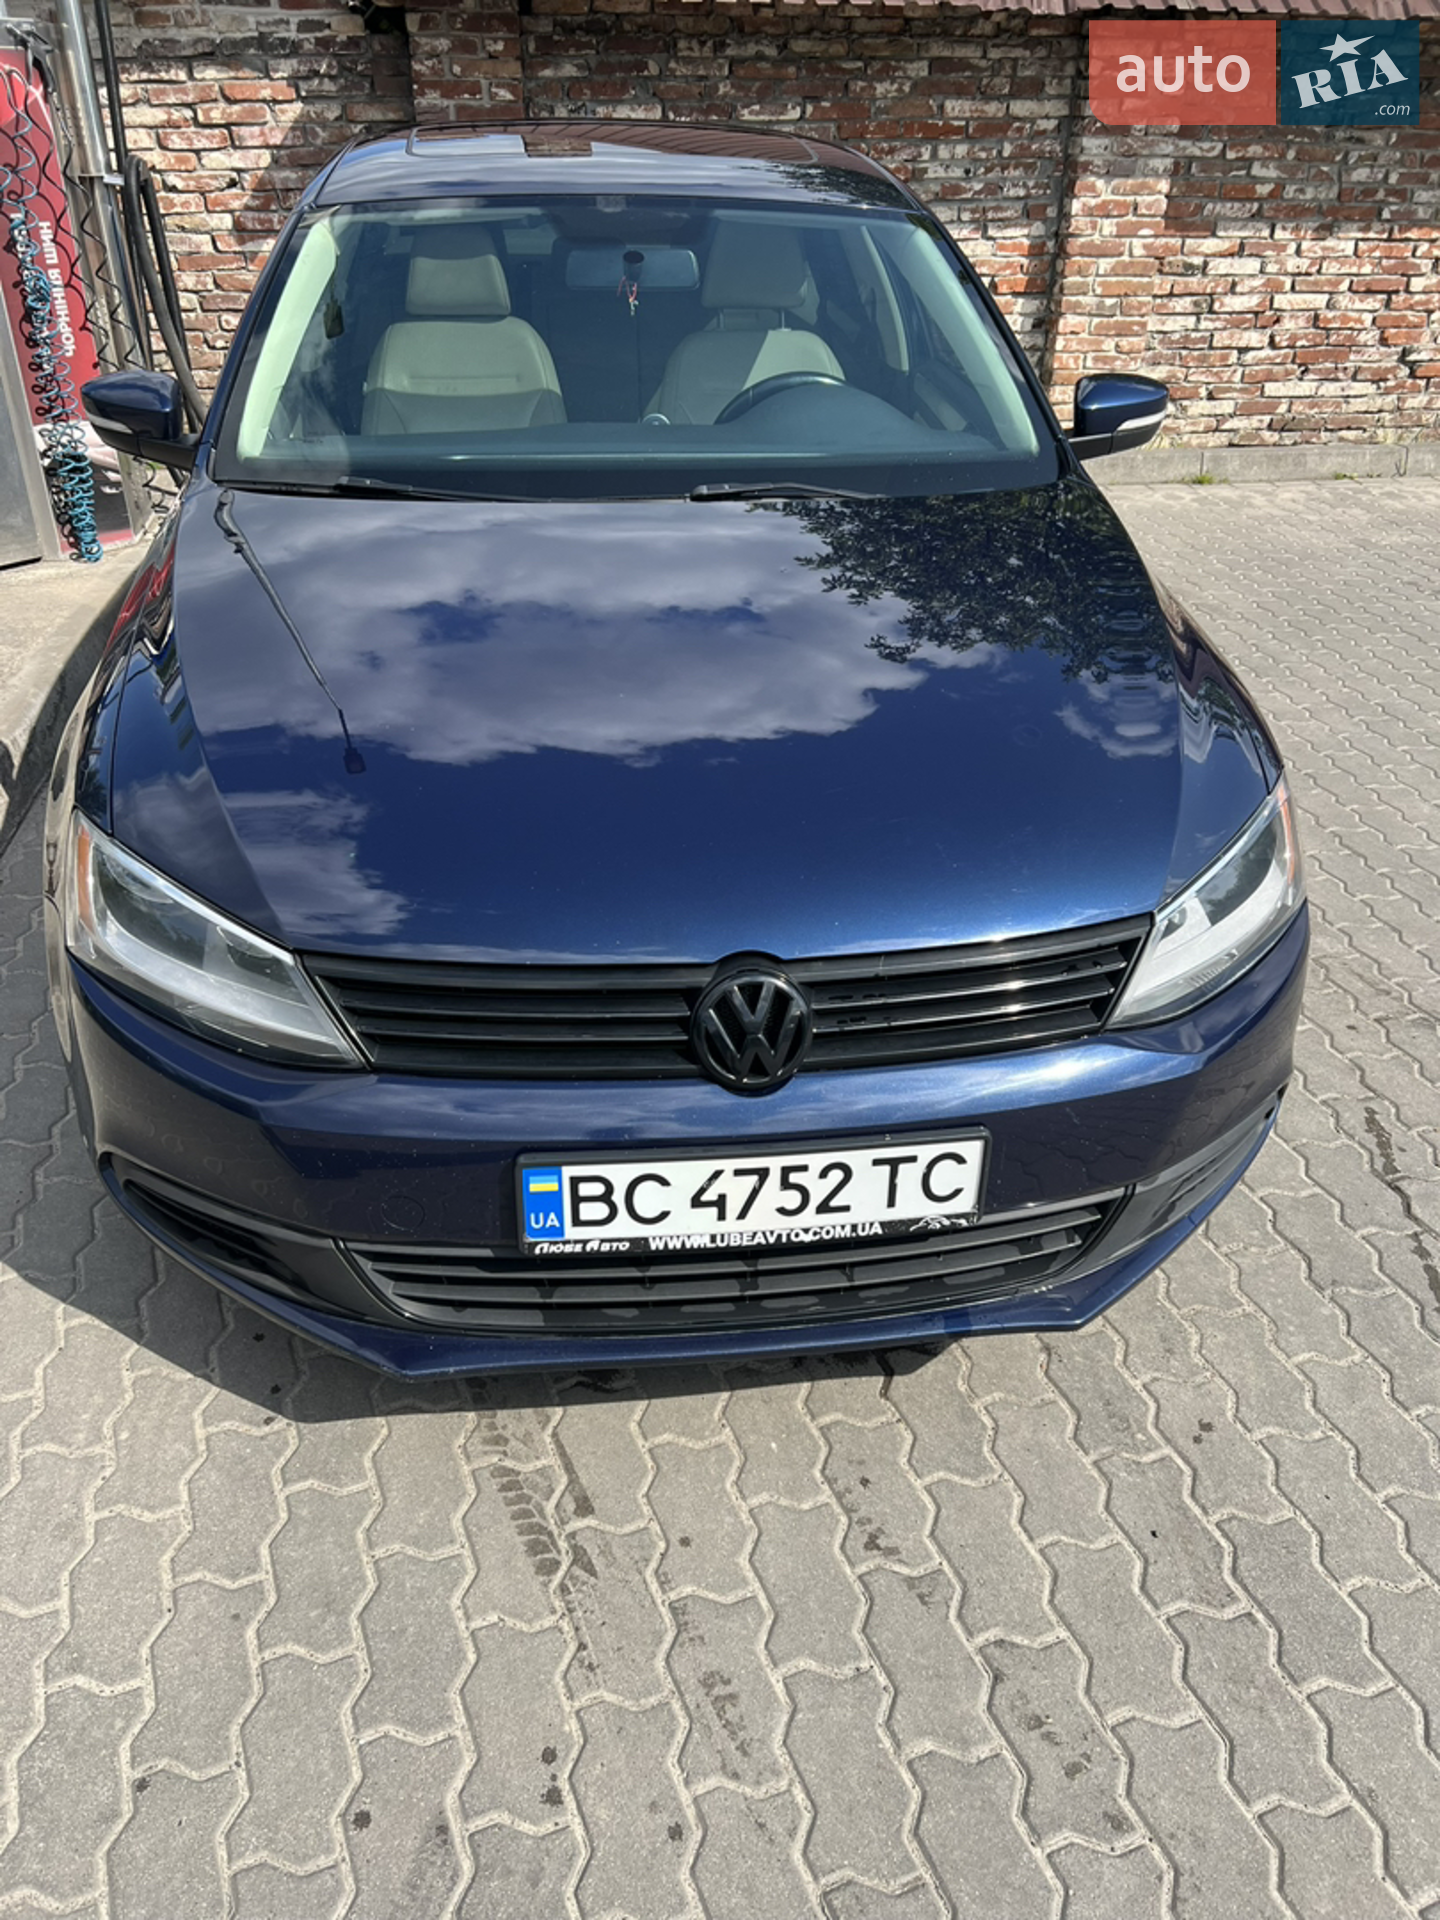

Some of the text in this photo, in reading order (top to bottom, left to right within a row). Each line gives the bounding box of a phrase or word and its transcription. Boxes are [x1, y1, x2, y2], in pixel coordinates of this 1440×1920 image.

[39, 221, 59, 265] ШИН
[569, 1152, 969, 1227] BC 4752 TC
[530, 1212, 561, 1230] UA
